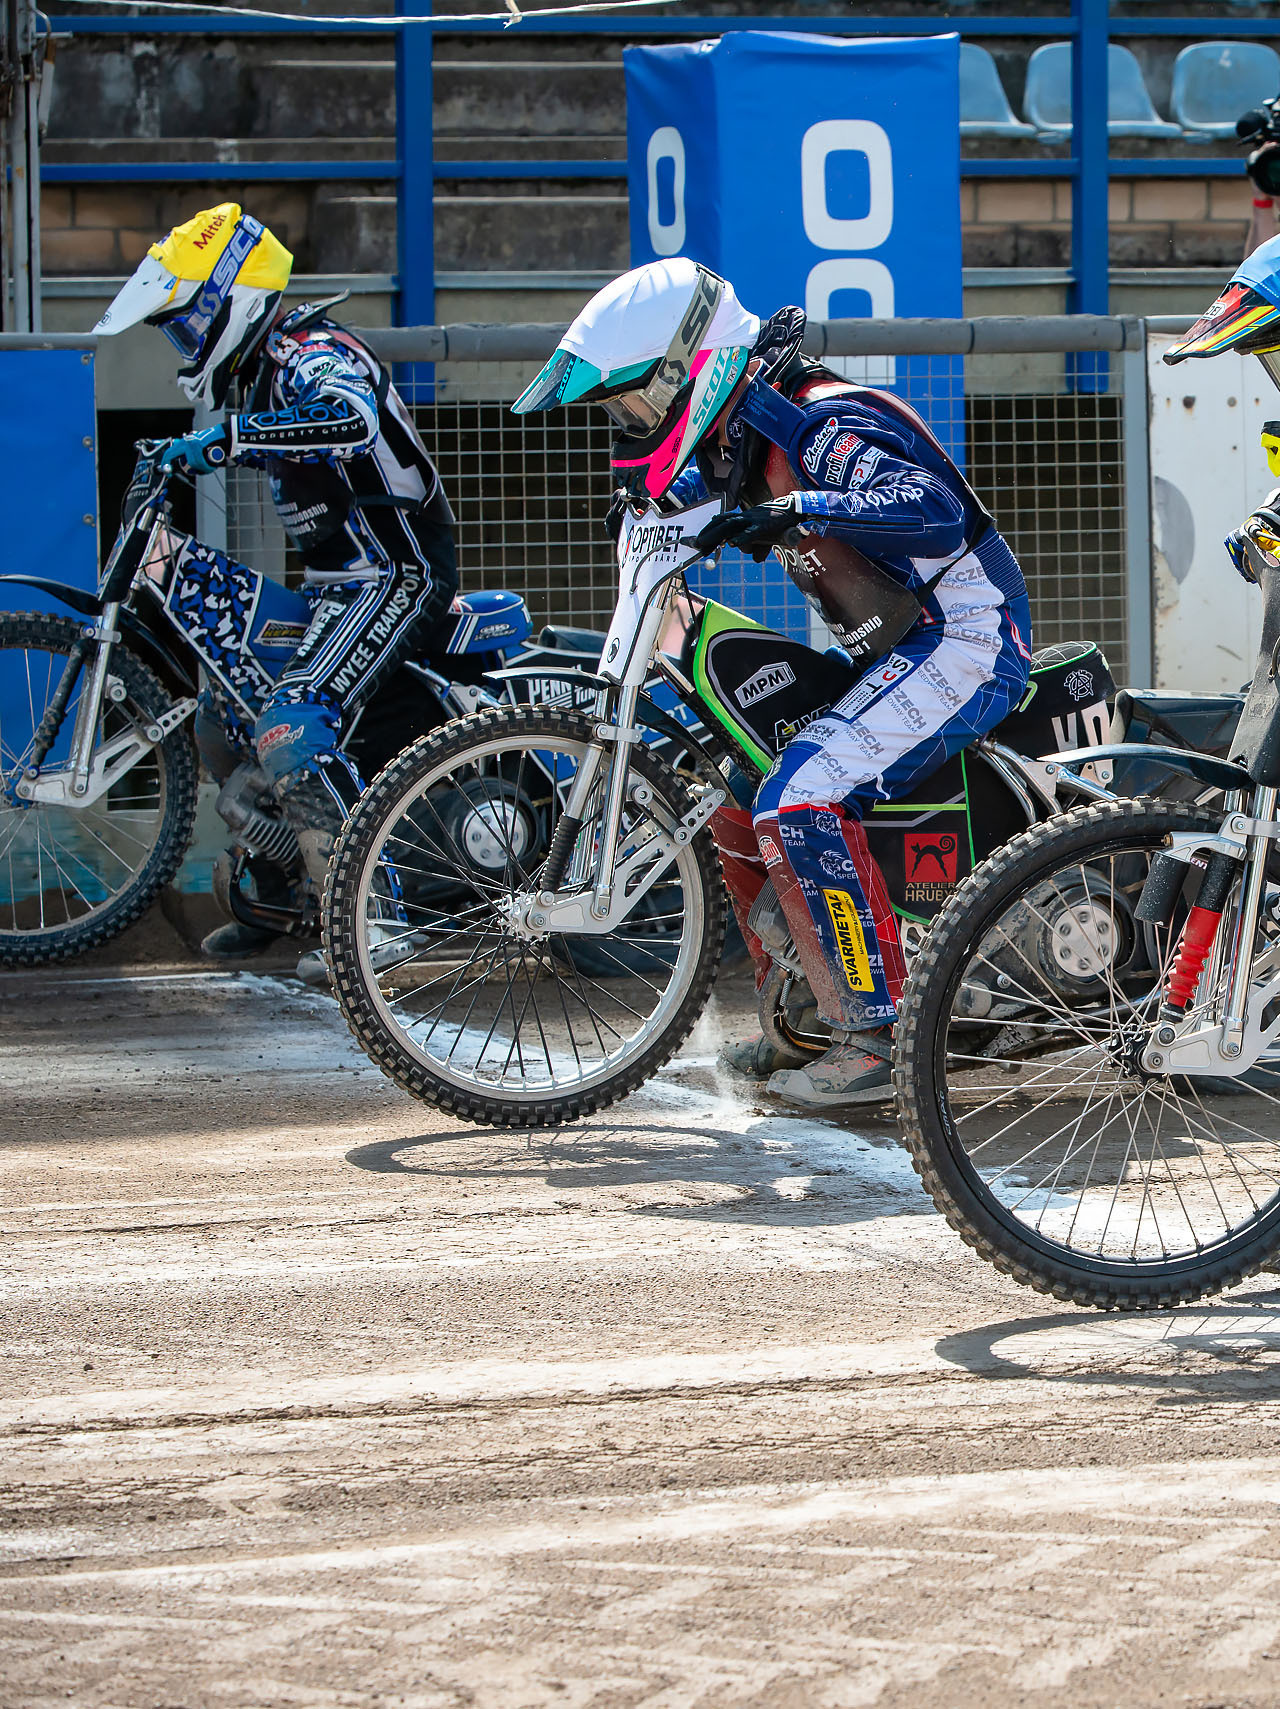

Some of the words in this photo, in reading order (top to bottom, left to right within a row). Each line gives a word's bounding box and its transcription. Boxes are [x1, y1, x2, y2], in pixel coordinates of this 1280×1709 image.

[193, 214, 227, 250] Mitch
[632, 525, 685, 554] OPTIBET
[329, 642, 376, 695] WYEE
[366, 561, 421, 647] TRANSPORT
[742, 669, 786, 702] MPM
[923, 660, 963, 708] CZECH
[938, 696, 953, 712] TEAM
[902, 716, 918, 734] TEAM
[857, 743, 874, 761] TEAM
[905, 882, 957, 890] ATELIER
[828, 893, 863, 987] SVARMETAL
